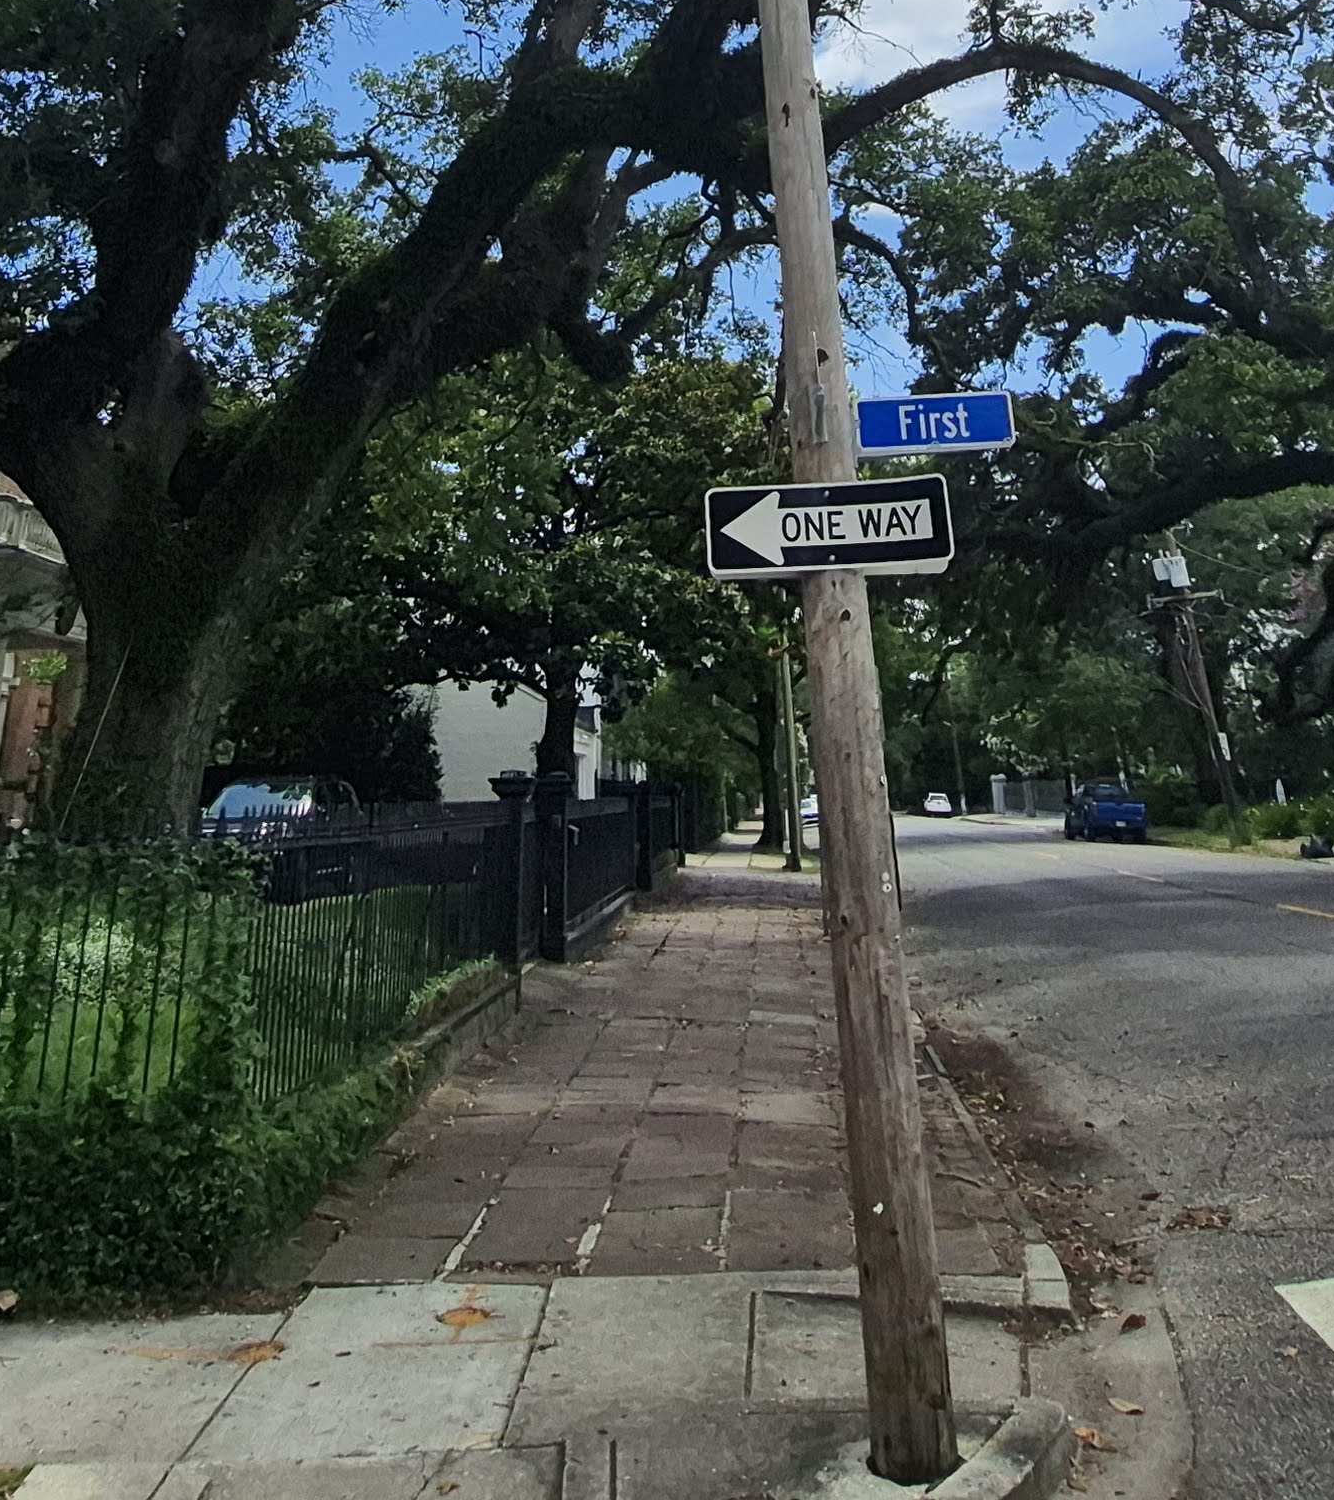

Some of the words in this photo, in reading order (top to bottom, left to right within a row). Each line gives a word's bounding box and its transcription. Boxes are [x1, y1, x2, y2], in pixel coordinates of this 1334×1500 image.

[898, 402, 971, 441] First
[781, 510, 846, 542] ONE
[857, 504, 923, 538] WAY
